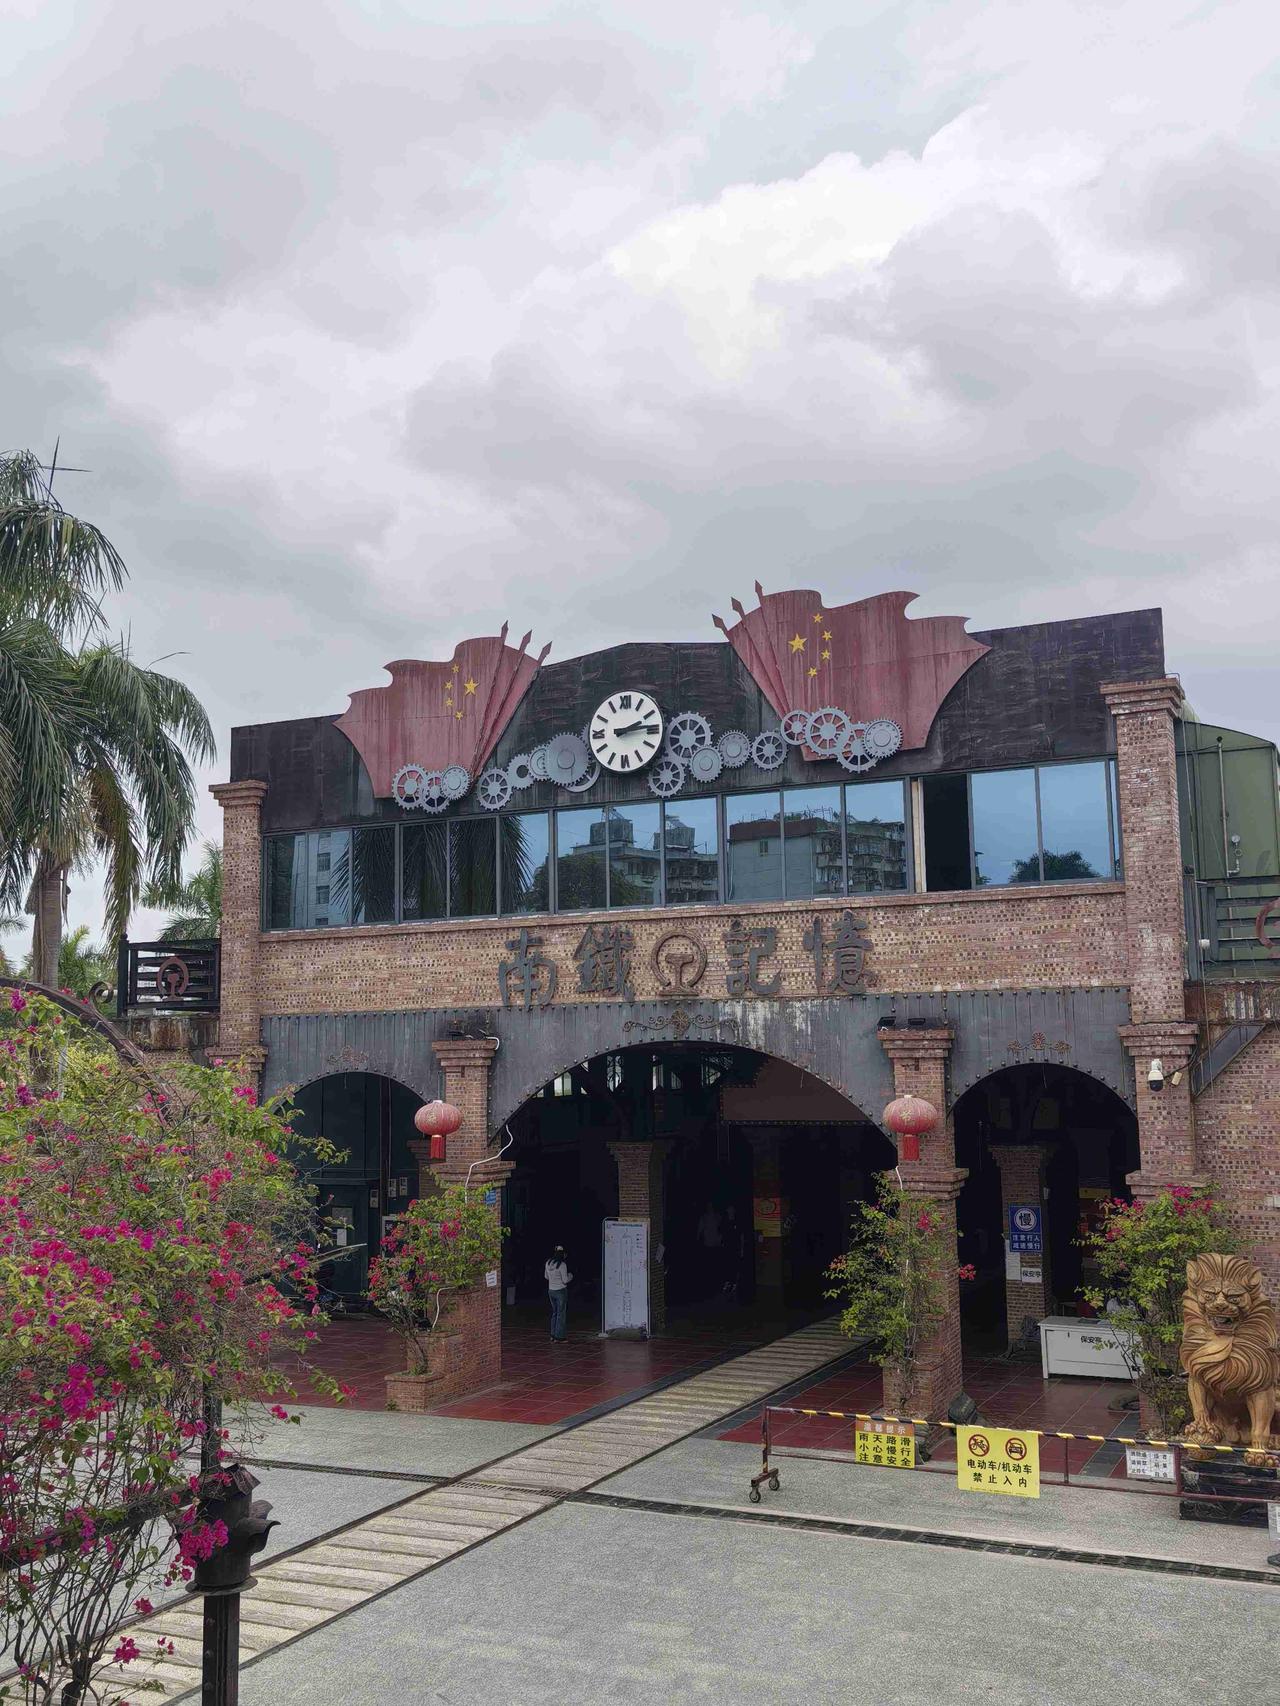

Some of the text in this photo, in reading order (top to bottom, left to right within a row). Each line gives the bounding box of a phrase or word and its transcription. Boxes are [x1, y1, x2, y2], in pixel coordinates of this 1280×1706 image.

[1019, 1213, 1032, 1227] 慢
[858, 1432, 911, 1447] 雨天路滑
[859, 1443, 912, 1457] 小心慢行
[859, 1452, 912, 1467] 注意安全
[967, 1458, 1033, 1474] 电动车/机动车
[973, 1471, 1028, 1488] 禁止入内
